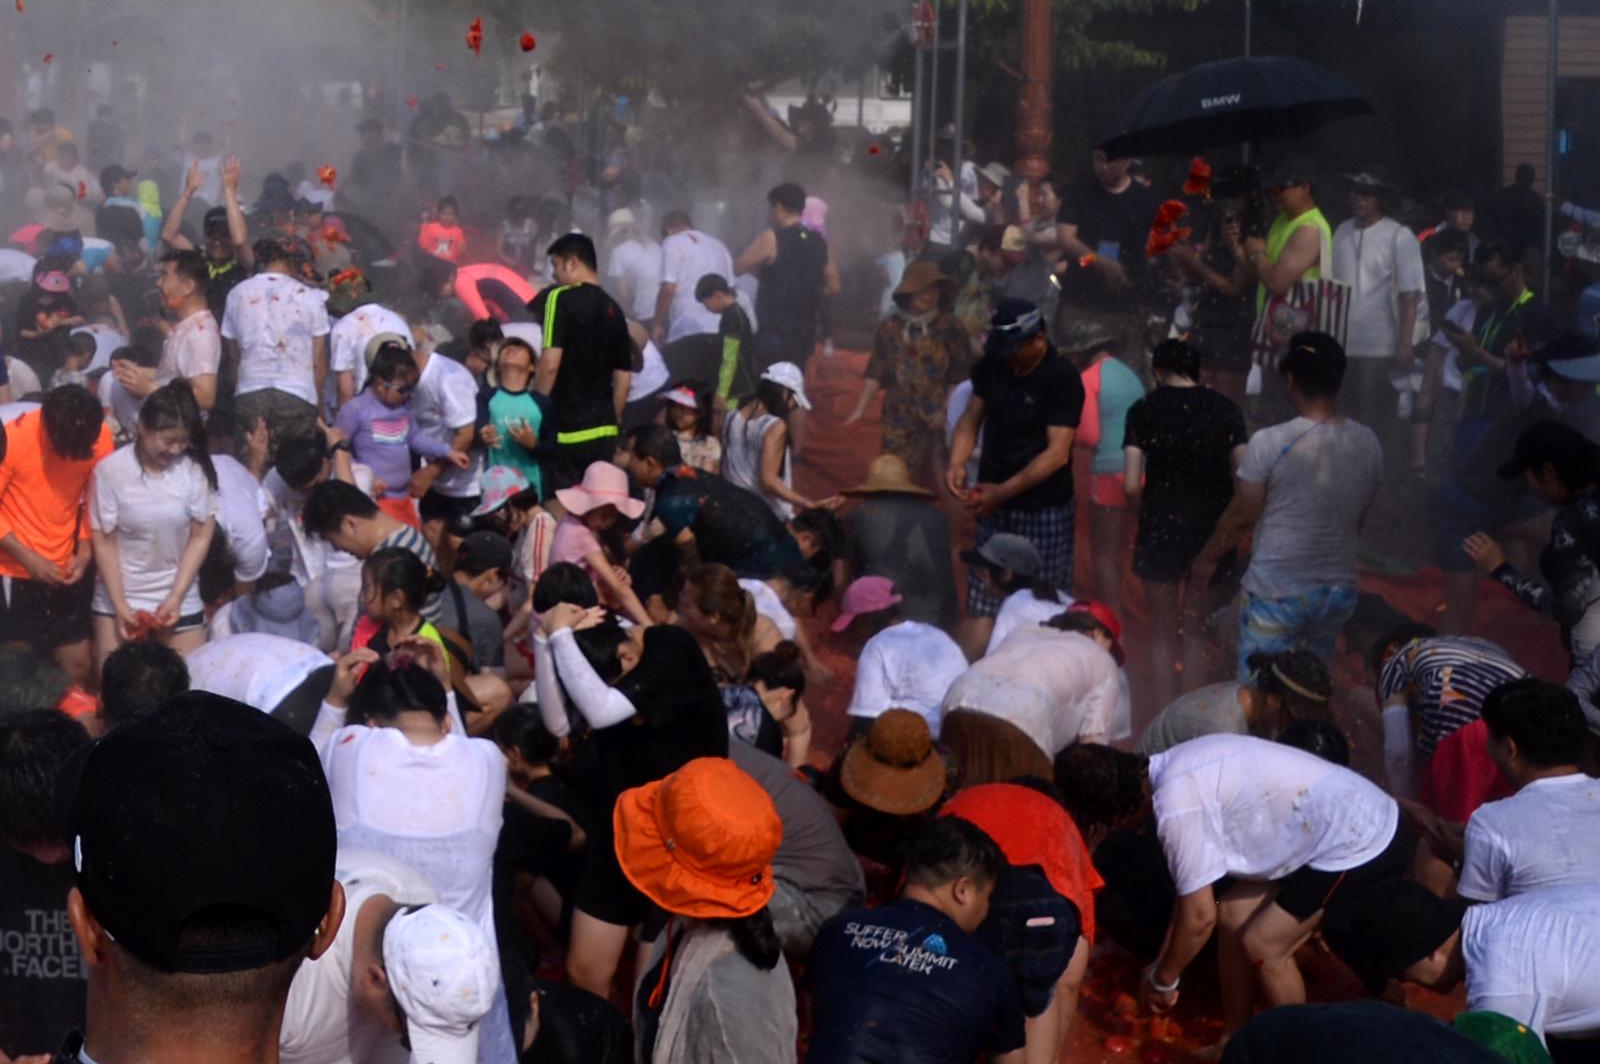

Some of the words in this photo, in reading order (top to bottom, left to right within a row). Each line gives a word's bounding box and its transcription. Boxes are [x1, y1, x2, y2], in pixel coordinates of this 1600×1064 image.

[1201, 93, 1241, 109] BMW
[24, 909, 73, 933] THE
[844, 921, 909, 941] SUFFER
[850, 936, 891, 949] NOW
[898, 941, 958, 970] SUMMIT
[11, 954, 79, 978] FACE
